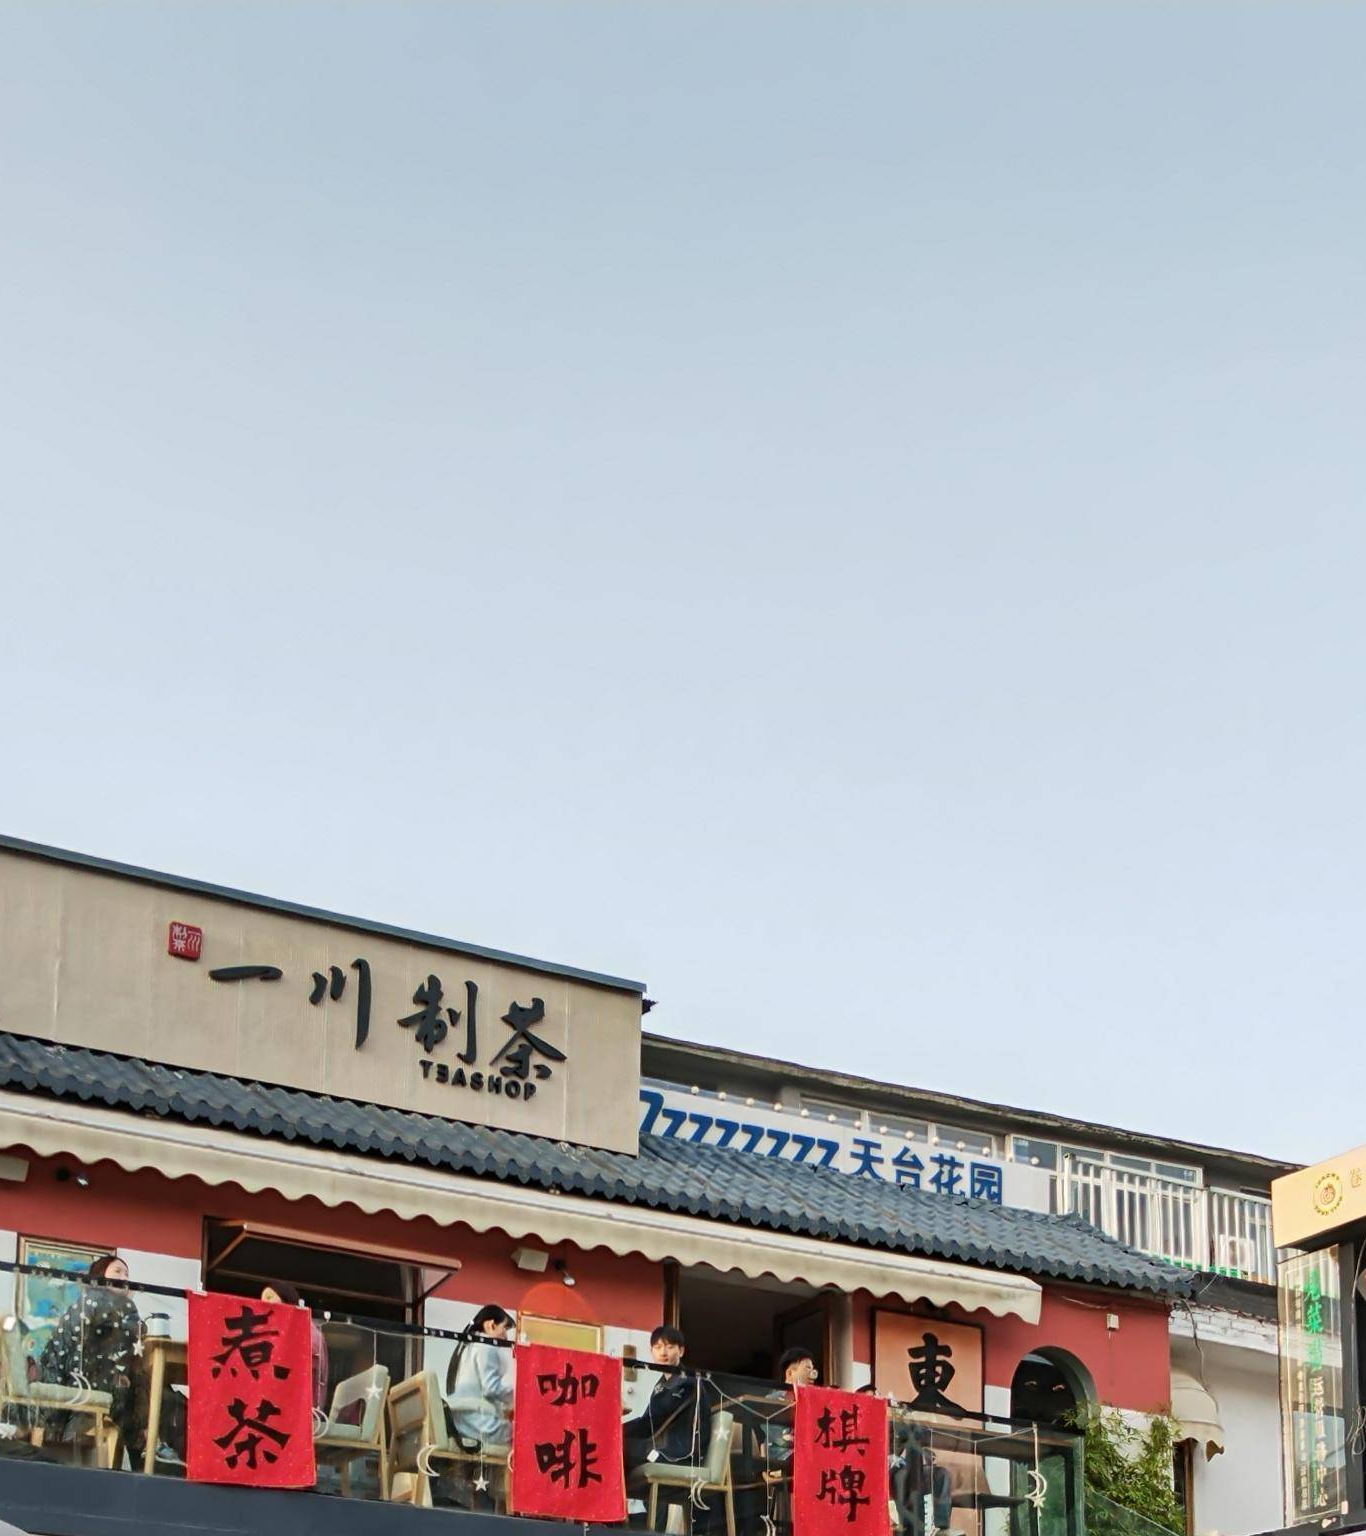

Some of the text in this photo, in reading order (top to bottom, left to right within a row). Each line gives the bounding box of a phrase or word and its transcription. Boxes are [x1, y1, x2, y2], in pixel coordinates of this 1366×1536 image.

[208, 958, 567, 1081] 一川制茶
[849, 1137, 1003, 1205] 天台花园
[212, 1306, 290, 1471] 煮茶
[535, 1362, 603, 1489] 咖啡
[907, 1333, 966, 1411] 東
[814, 1403, 871, 1524] 棋牌
